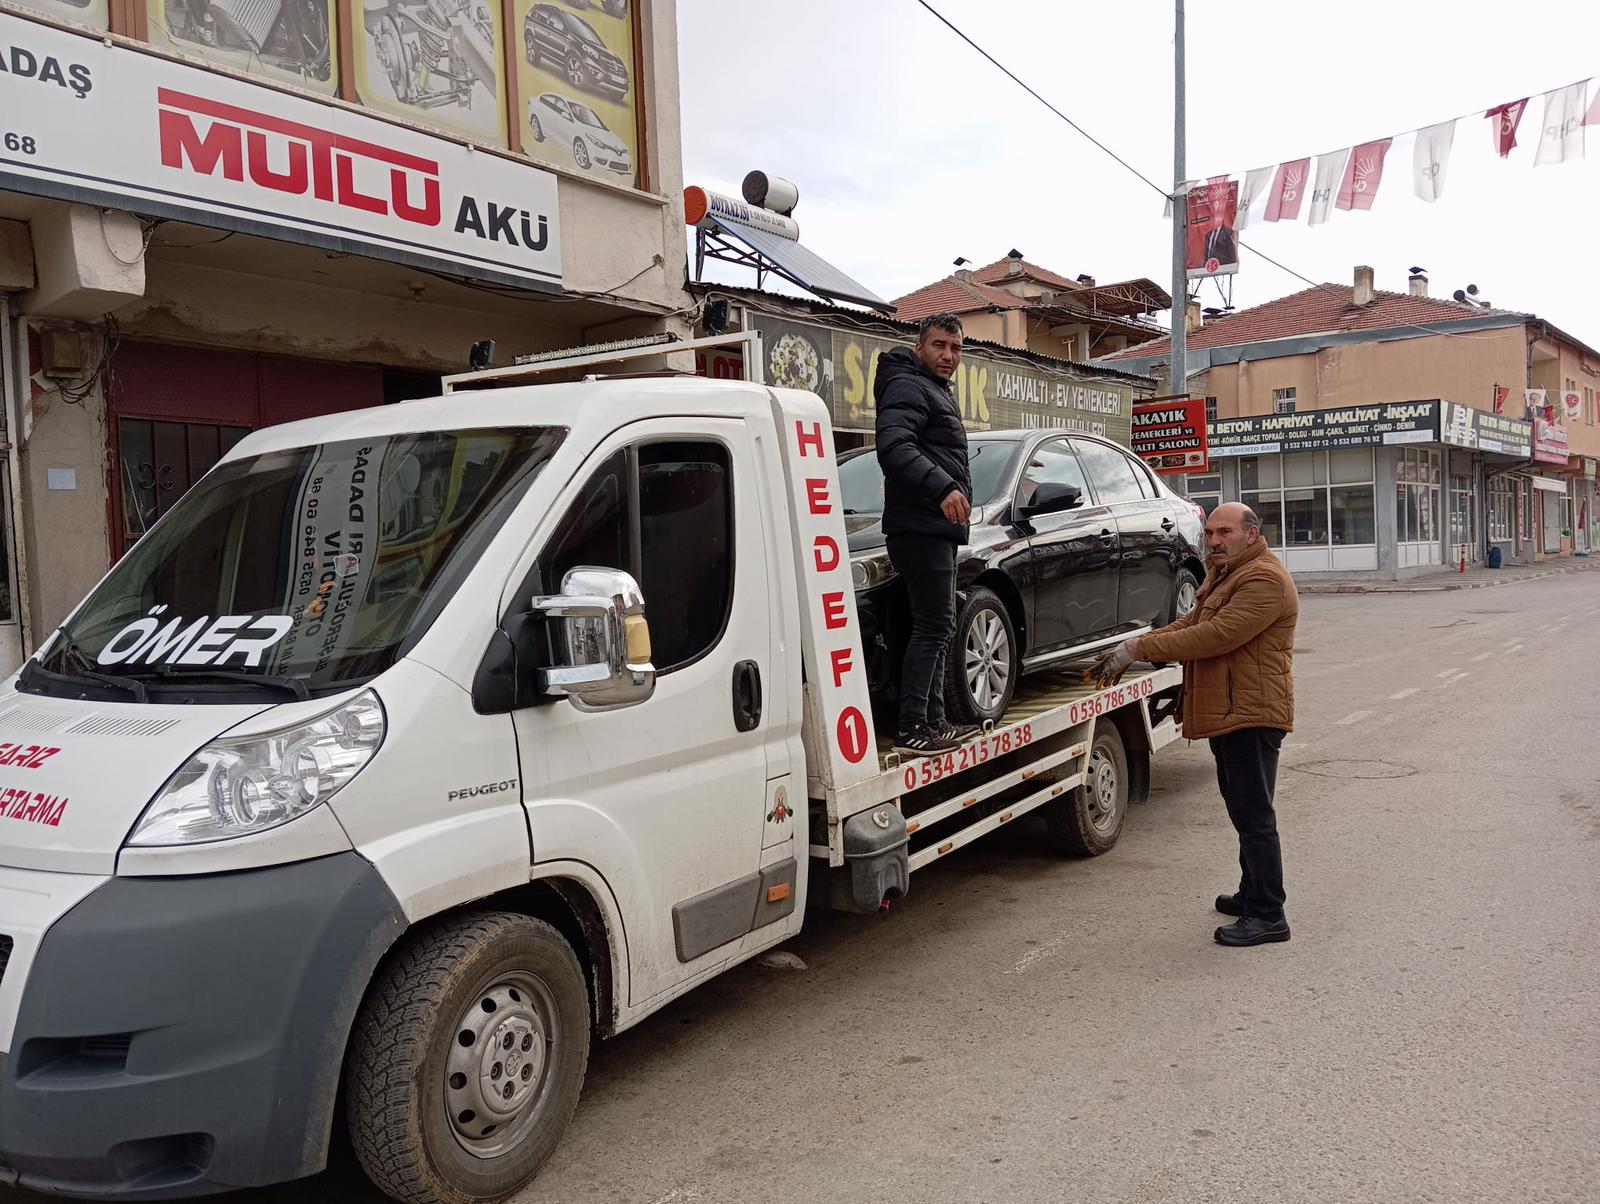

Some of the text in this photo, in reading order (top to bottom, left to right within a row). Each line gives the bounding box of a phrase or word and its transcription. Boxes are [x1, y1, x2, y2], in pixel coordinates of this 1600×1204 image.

[0, 46, 92, 99] DAŞ
[4, 132, 36, 155] 68
[158, 87, 549, 252] MUTLU AKÜ
[996, 371, 1049, 405] KAHVALTI
[1056, 383, 1070, 408] EV
[1216, 420, 1253, 434] BETON
[1261, 414, 1316, 430] HAFRİYAT
[1324, 407, 1381, 425] NAKLİYAT
[1288, 430, 1308, 439] DOLGU
[1311, 429, 1325, 437] KUM
[1158, 438, 1200, 450] SALONU
[795, 420, 853, 688] HEDEF
[97, 604, 294, 667] ÖMER
[1070, 704, 1078, 724] 0
[1081, 697, 1102, 721] 536
[1104, 688, 1125, 711] 786
[1141, 677, 1153, 696] 03
[904, 723, 1032, 790] 0 534 215 78 38
[448, 778, 517, 801] PEUGEOT
